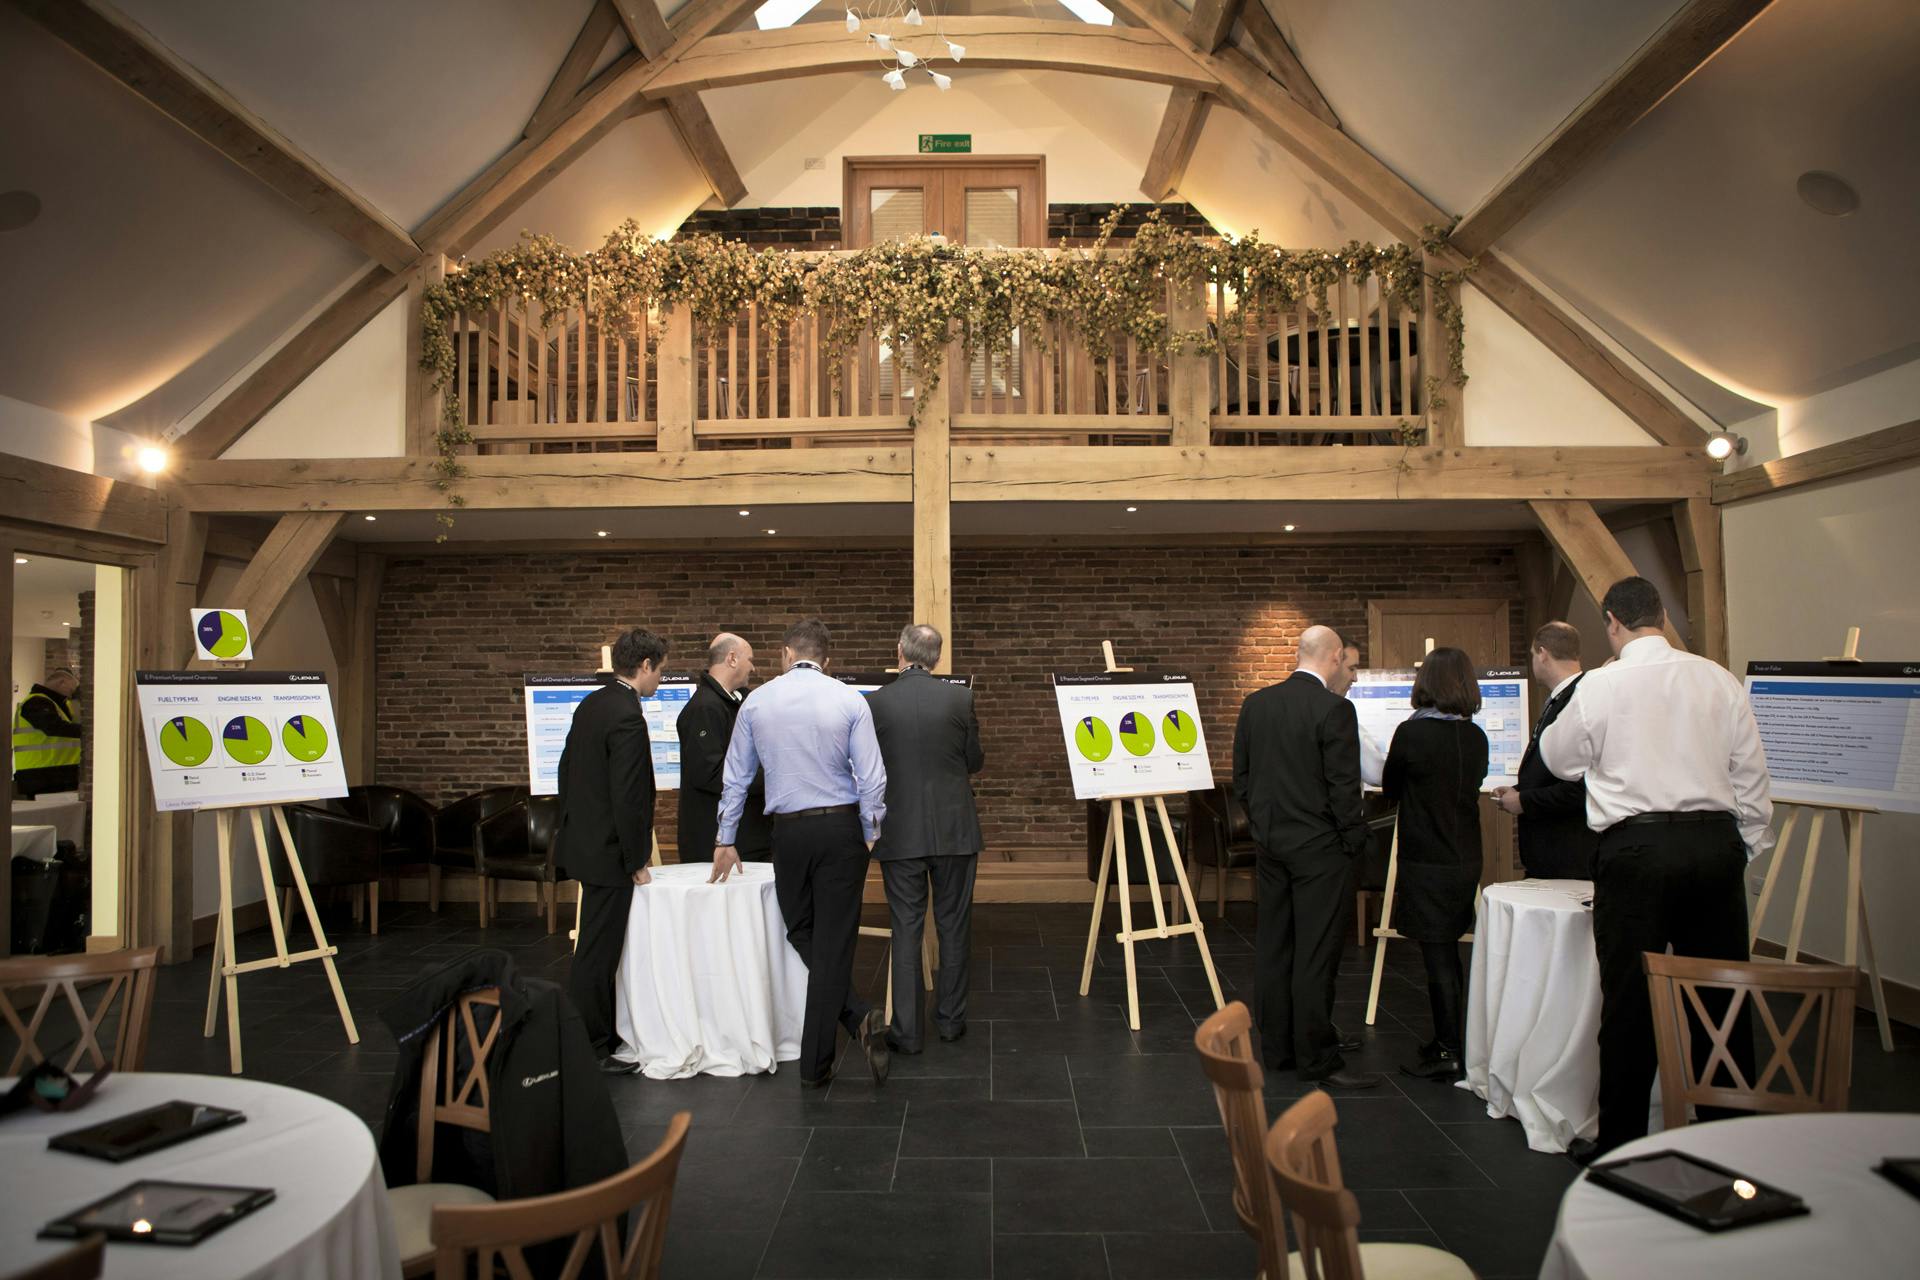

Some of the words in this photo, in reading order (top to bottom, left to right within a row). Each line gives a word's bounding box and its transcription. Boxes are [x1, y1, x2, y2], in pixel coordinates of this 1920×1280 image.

[935, 140, 952, 148] Fire
[954, 140, 970, 148] exit
[548, 676, 571, 684] Ownership
[571, 676, 598, 684] Comparison
